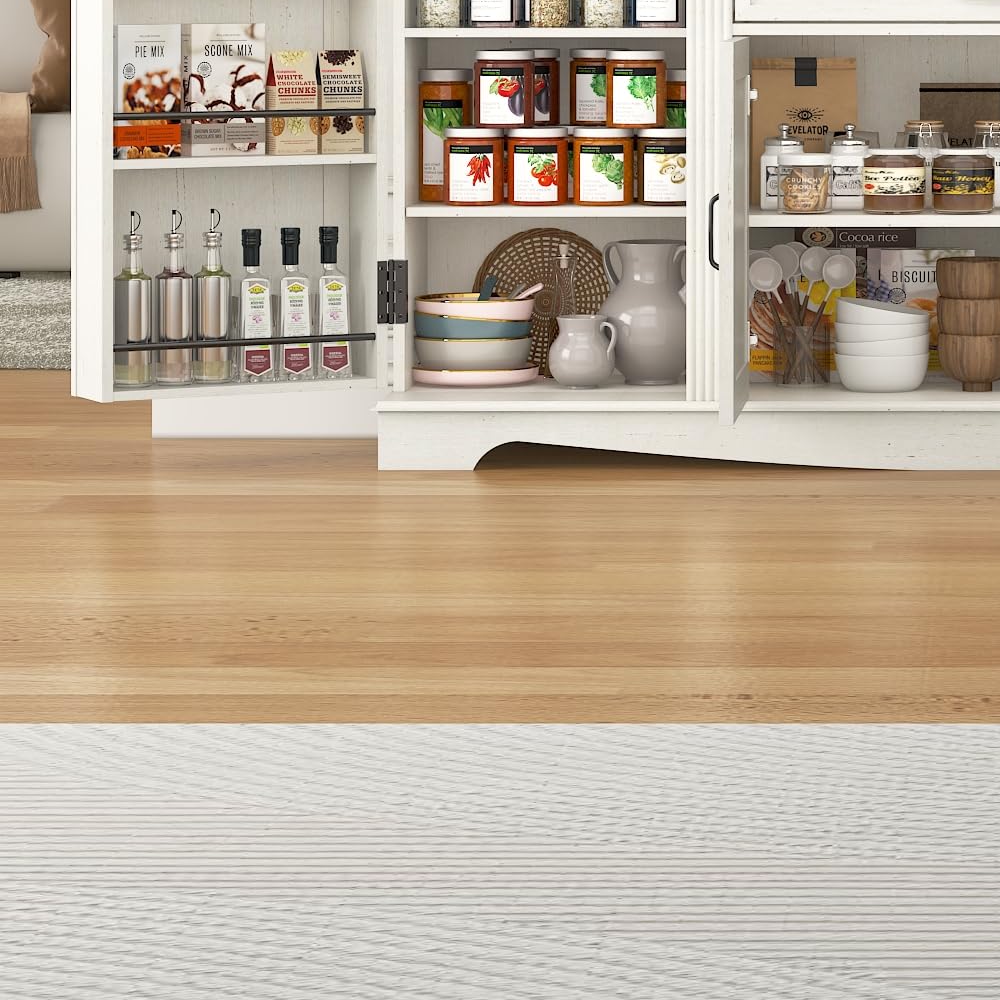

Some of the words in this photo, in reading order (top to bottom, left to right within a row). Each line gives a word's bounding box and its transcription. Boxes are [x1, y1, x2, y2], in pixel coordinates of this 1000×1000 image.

[135, 46, 147, 58] PIE
[151, 45, 165, 58] MIX
[204, 44, 233, 57] SCONE
[237, 44, 253, 57] MIX
[278, 86, 317, 94] CHUNKS
[323, 85, 363, 93] CHUNKS
[787, 125, 829, 136] EVELATOR
[838, 232, 875, 242] Cocoa
[877, 232, 899, 242] rice
